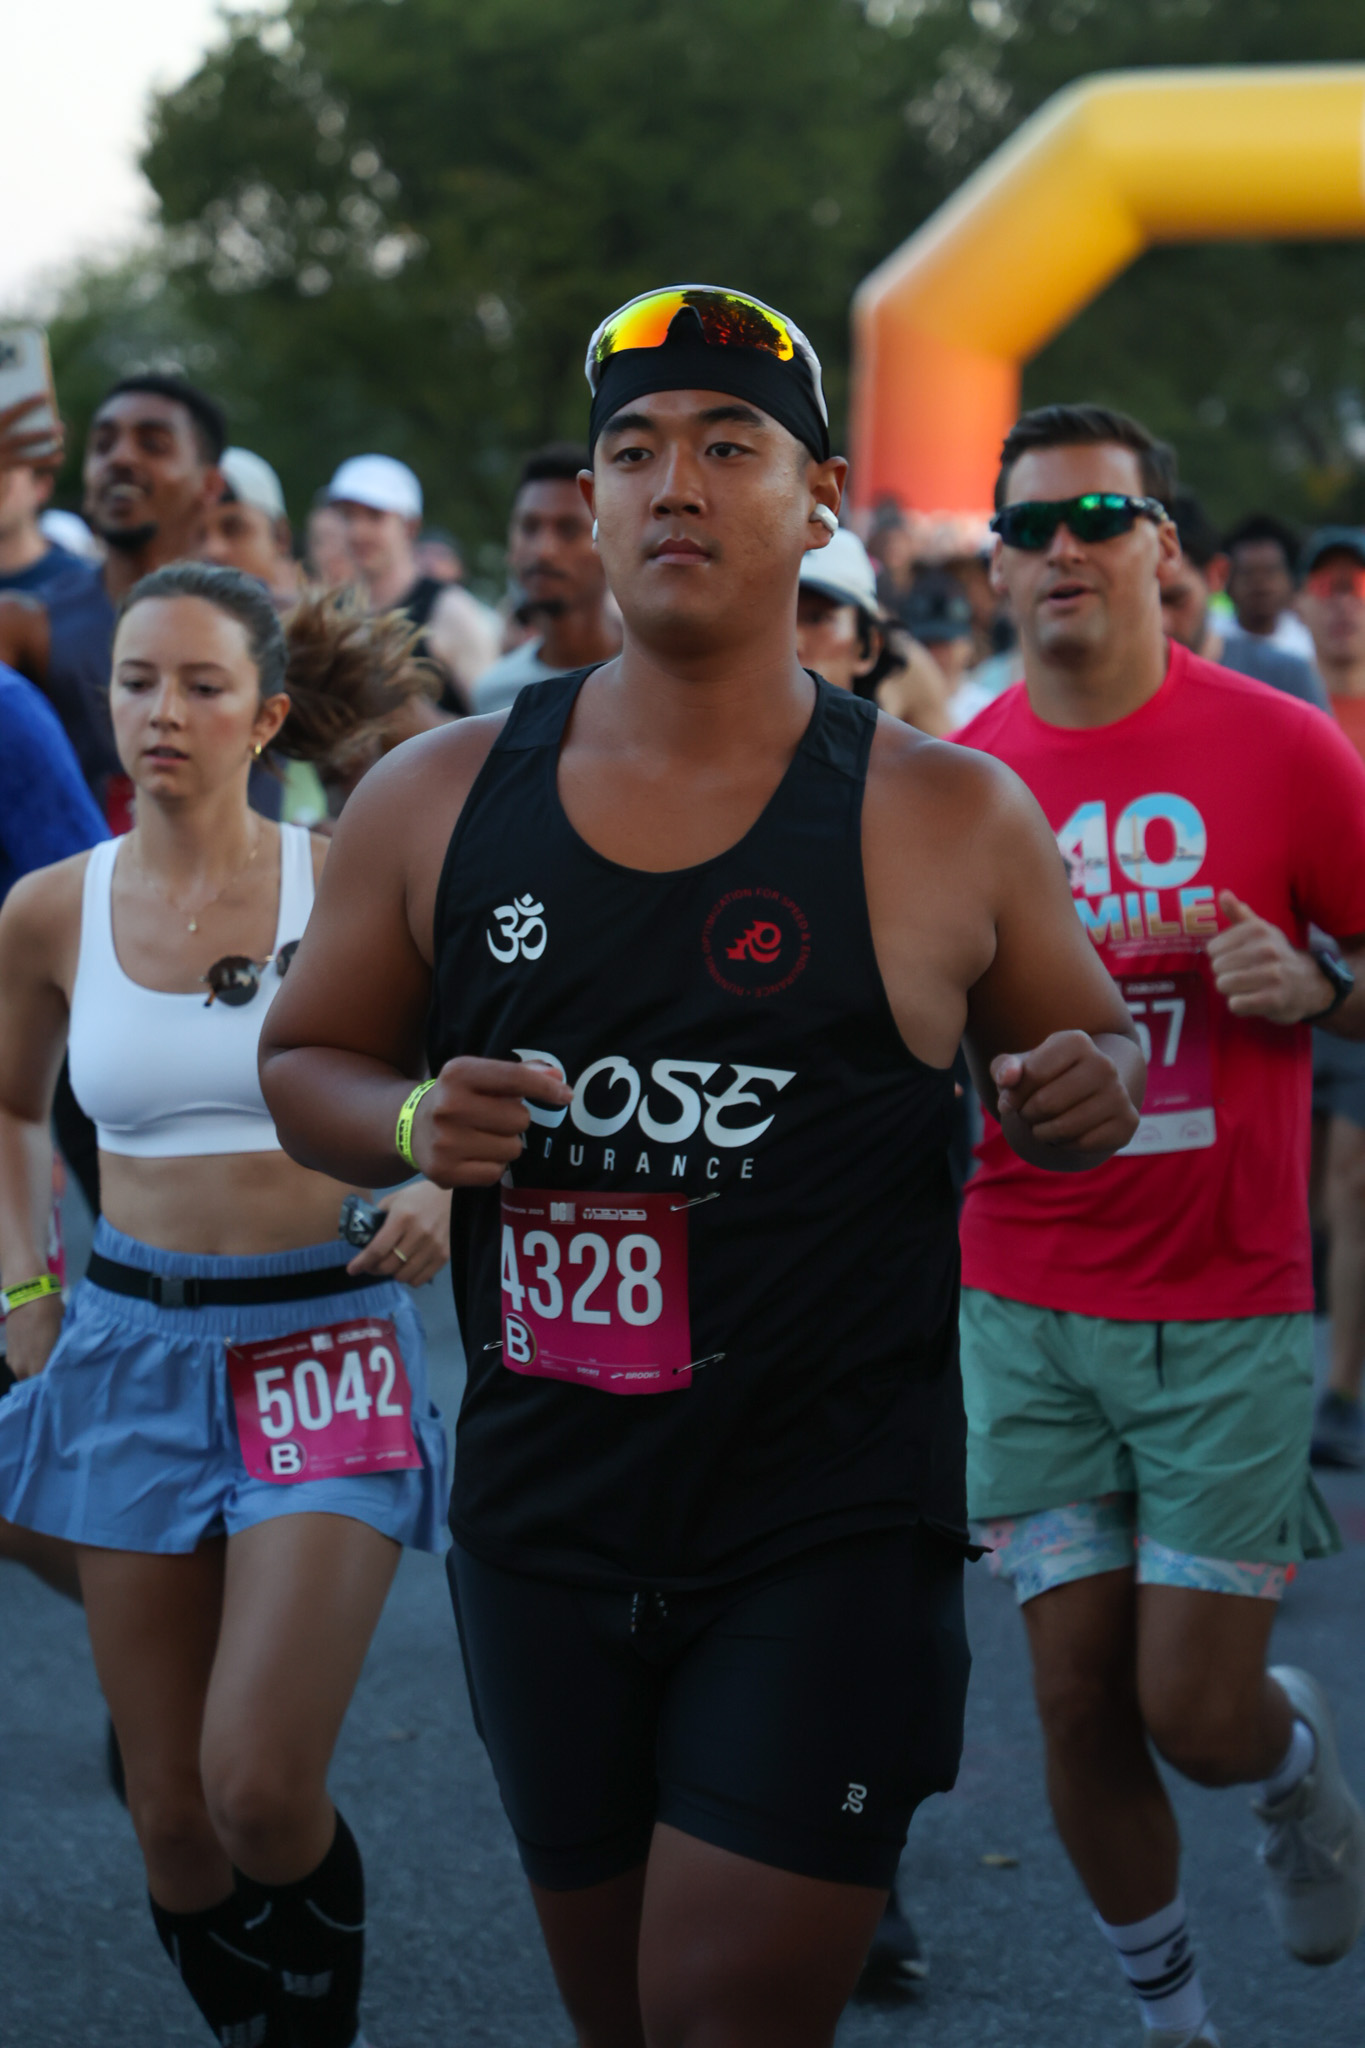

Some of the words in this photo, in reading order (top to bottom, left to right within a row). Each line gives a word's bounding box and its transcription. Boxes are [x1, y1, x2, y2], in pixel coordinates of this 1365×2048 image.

[1056, 792, 1207, 896] 40
[756, 887, 780, 900] FOR
[781, 896, 808, 930] SPEED
[1073, 886, 1218, 944] MILE
[500, 1223, 664, 1327] 4328
[506, 1316, 532, 1364] B
[253, 1345, 404, 1439] 5042
[625, 1371, 660, 1380] BROOKS
[269, 1442, 302, 1476] B
